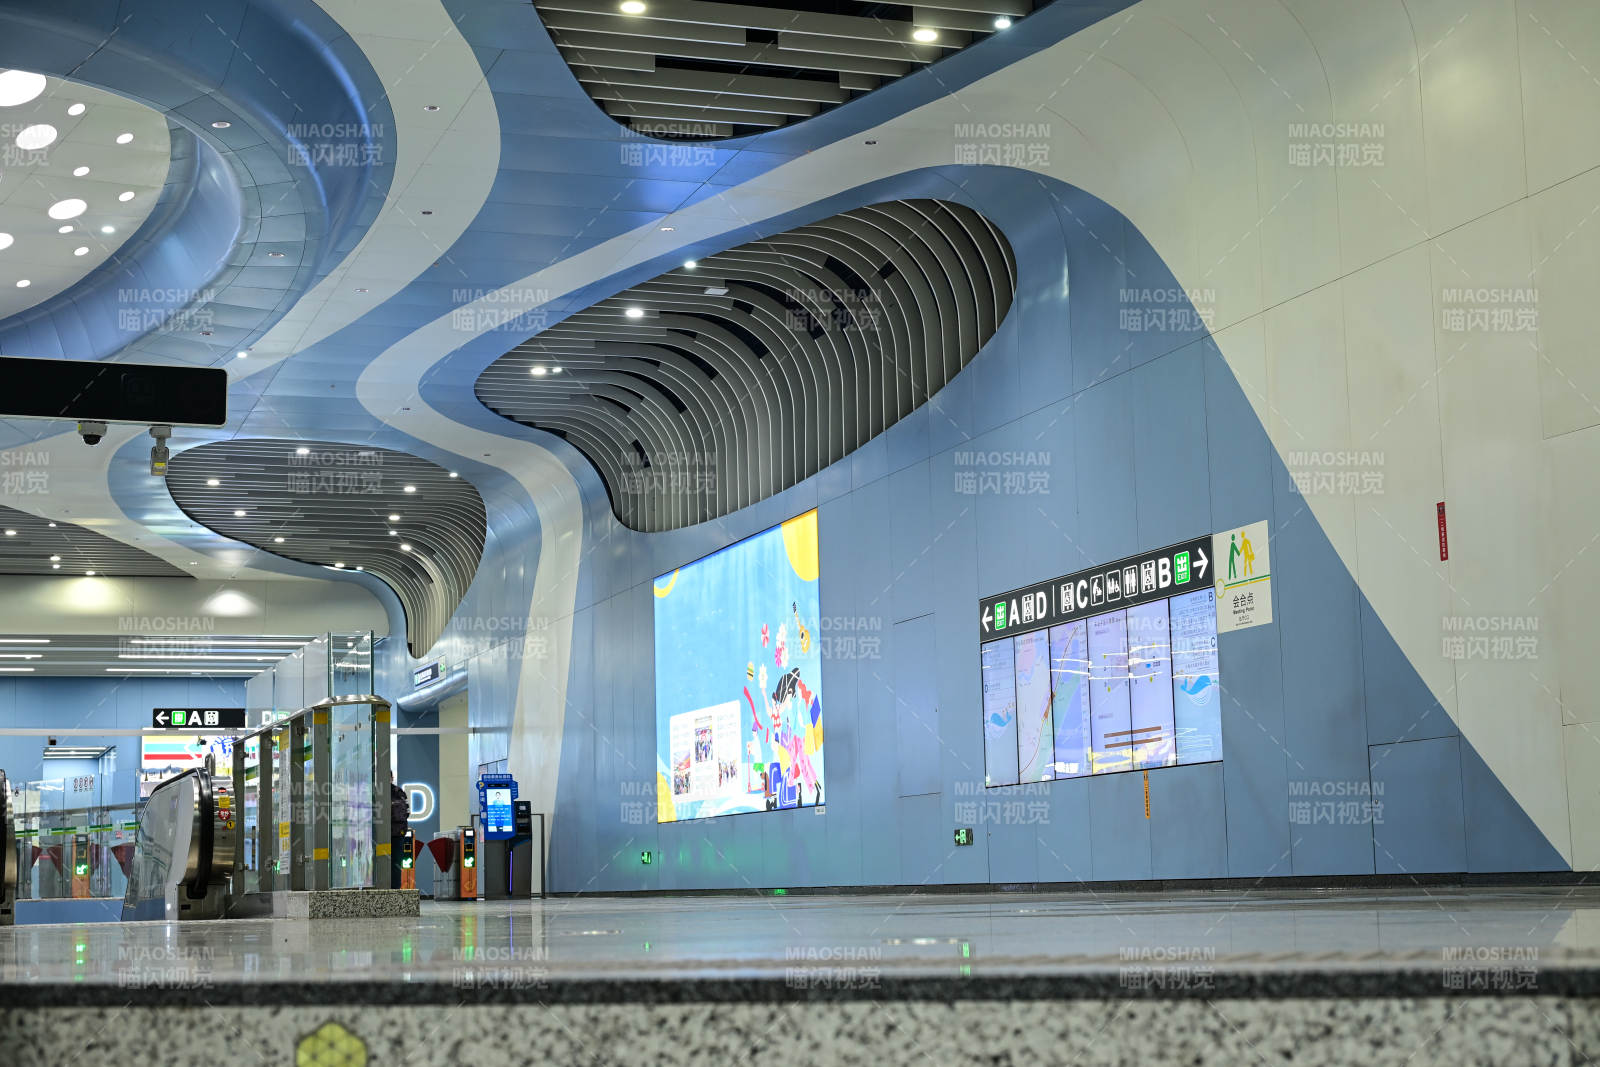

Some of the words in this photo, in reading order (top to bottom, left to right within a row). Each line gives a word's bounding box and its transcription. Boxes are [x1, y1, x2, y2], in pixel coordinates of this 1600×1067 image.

[1076, 579, 1088, 609] C
[1158, 557, 1172, 589] B
[1008, 598, 1021, 627] A
[1036, 591, 1047, 620] D
[1208, 591, 1214, 602] B
[1210, 637, 1216, 648] C
[188, 711, 202, 726] A
[401, 782, 435, 822] D
